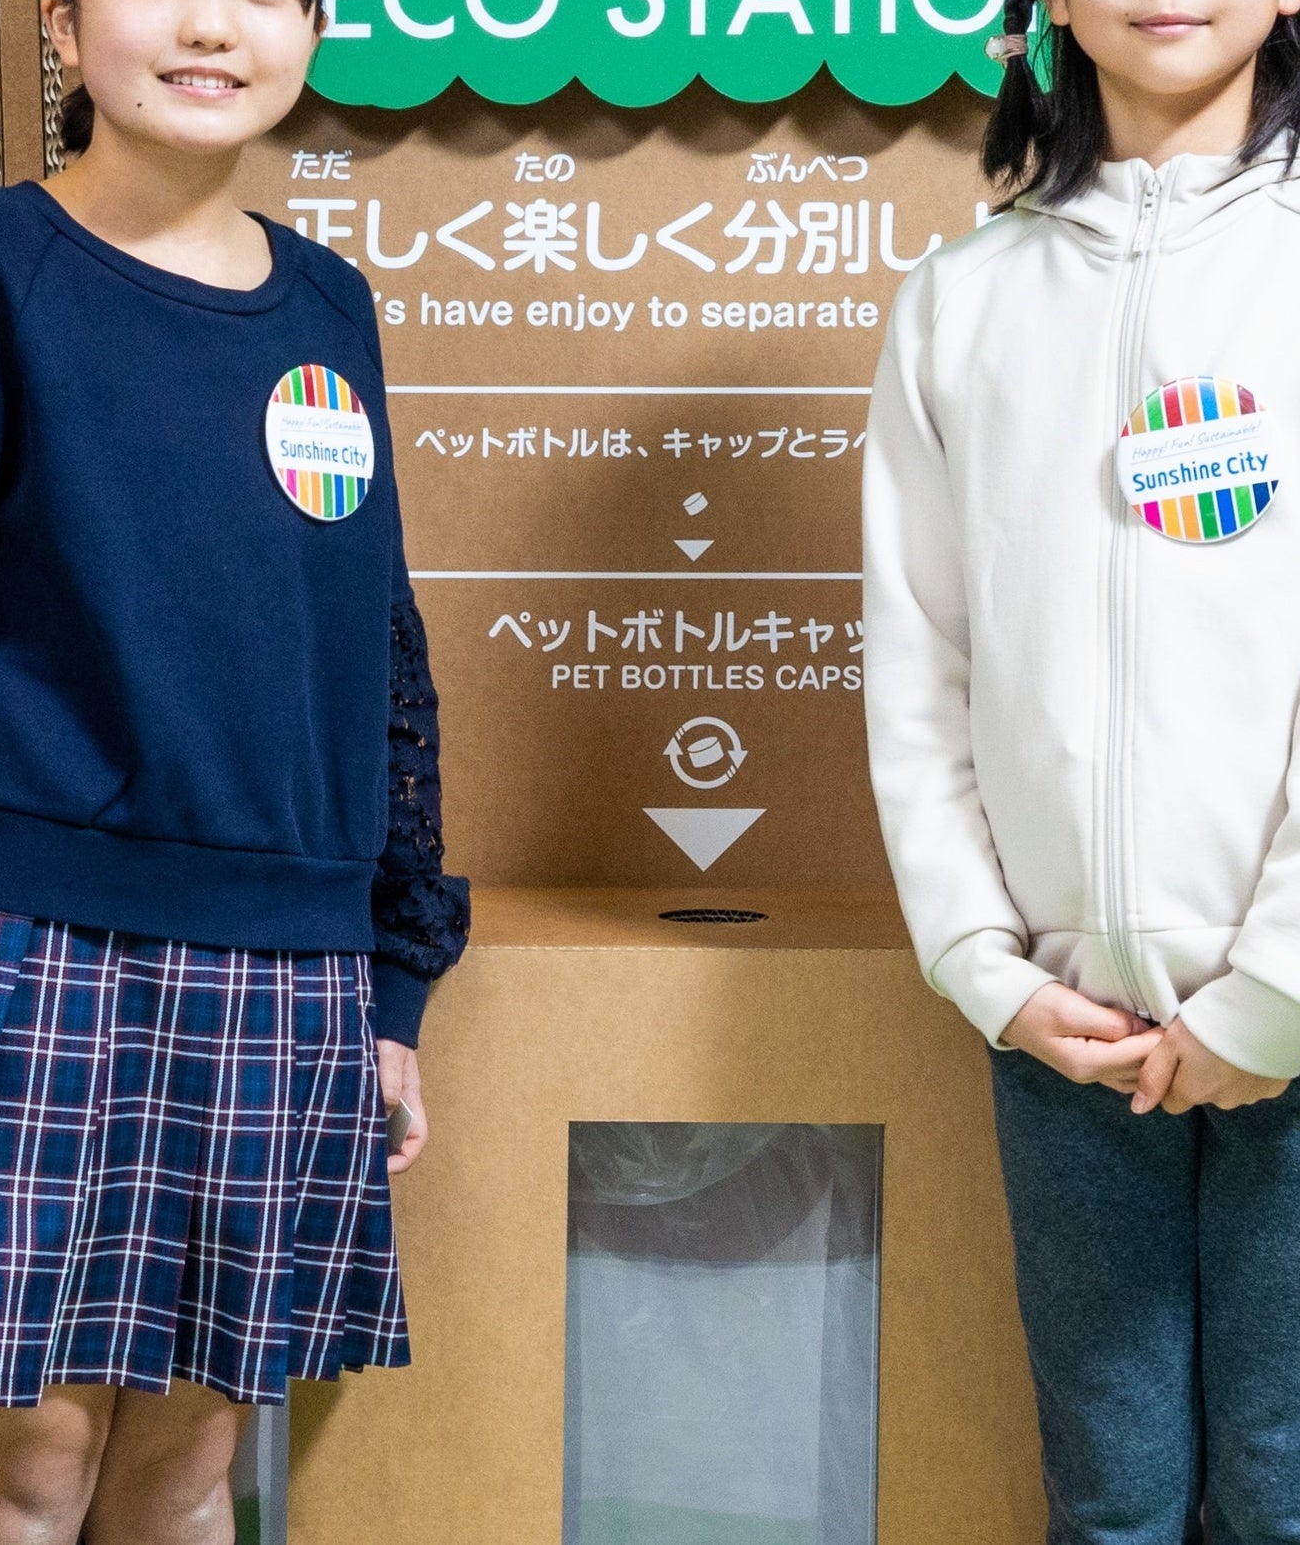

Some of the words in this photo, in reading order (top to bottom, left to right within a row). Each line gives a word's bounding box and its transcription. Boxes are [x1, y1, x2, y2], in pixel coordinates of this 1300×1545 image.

[290, 149, 353, 181] ただ
[514, 151, 576, 183] たの
[746, 152, 869, 184] ぶんべつ
[286, 198, 1003, 274] 正しく楽しく分別し
[420, 292, 514, 327] have
[526, 293, 635, 332] enjoy
[647, 295, 689, 328] to
[701, 296, 879, 332] separate
[280, 439, 339, 463] Sunshine
[341, 446, 367, 468] City
[1132, 461, 1221, 493] Sunshine
[1226, 451, 1268, 476] City
[552, 664, 611, 690] PET
[621, 664, 765, 690] BOTTLES
[775, 664, 862, 691] CAPS
